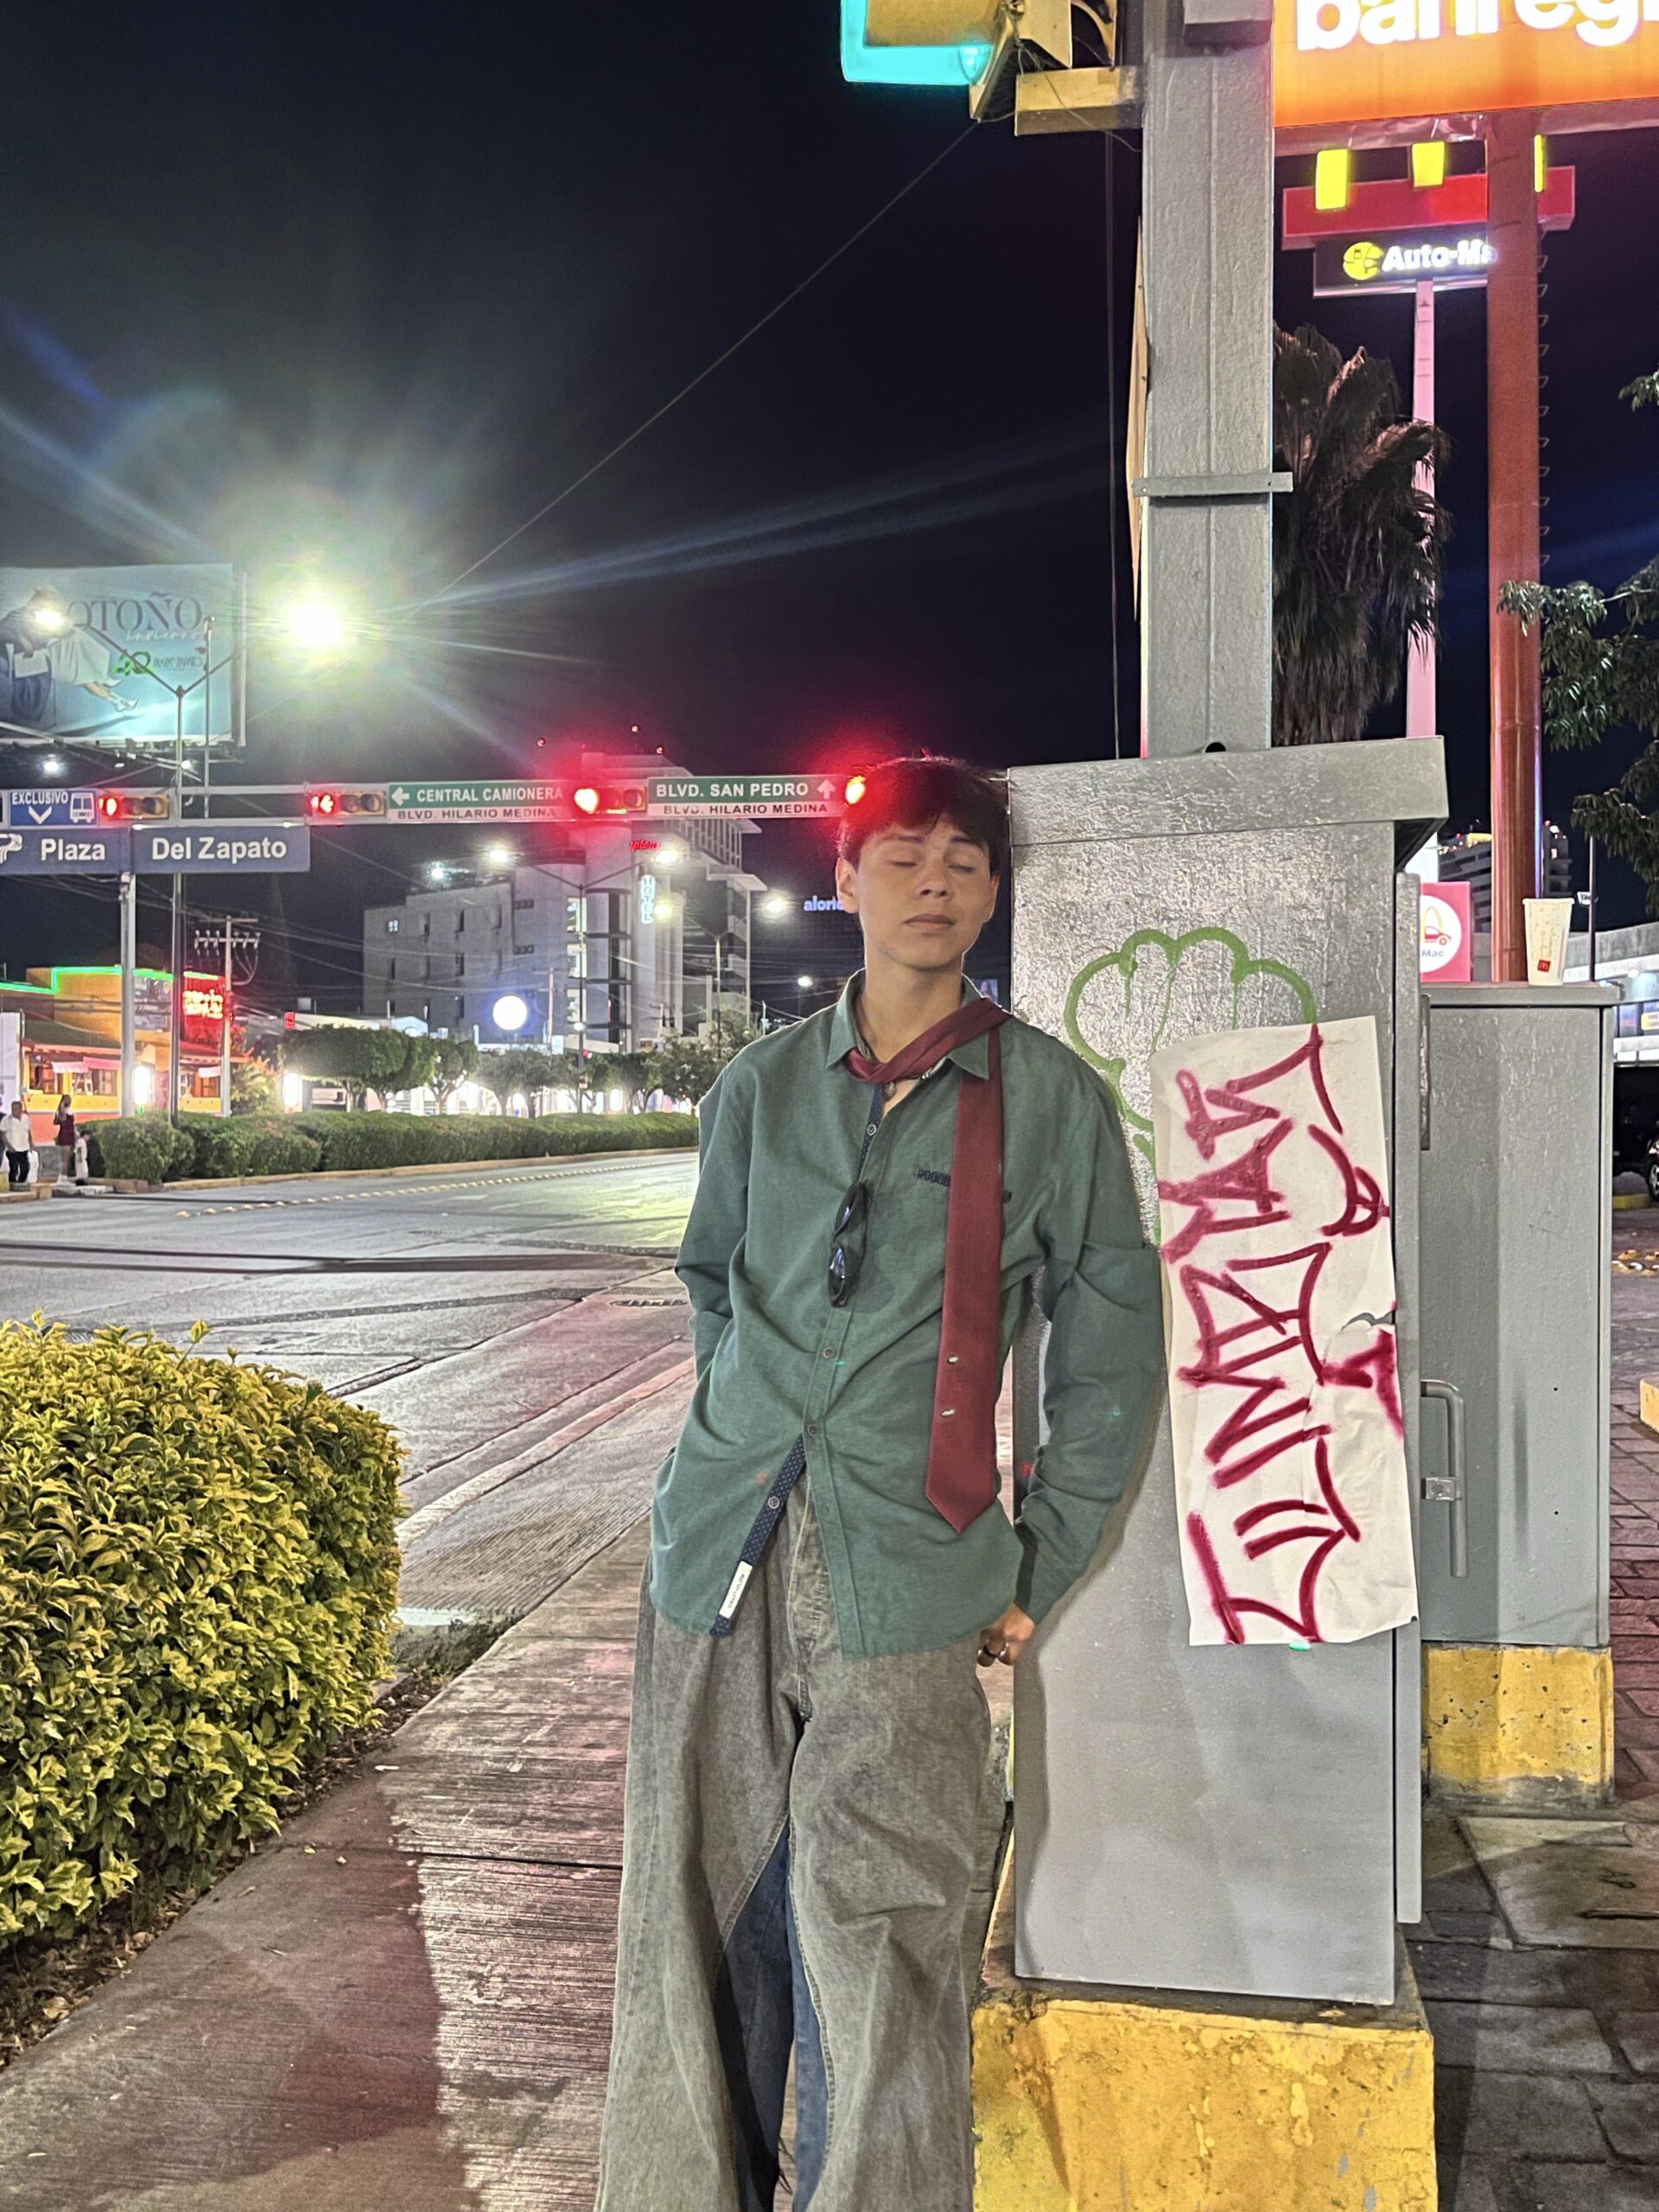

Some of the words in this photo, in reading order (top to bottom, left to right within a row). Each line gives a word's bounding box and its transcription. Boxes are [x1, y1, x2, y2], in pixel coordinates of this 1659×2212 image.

[416, 787, 479, 803] CENTRAL
[482, 786, 563, 802] CAMIONERA
[656, 784, 703, 798] BLVD.
[709, 783, 745, 798] SAN
[750, 782, 809, 797] PEDRO
[12, 791, 69, 805] EXCLUSIVO
[397, 810, 438, 820] BLVD.
[442, 809, 499, 819] HILARIO
[503, 807, 556, 818] MEDINA
[709, 804, 767, 814] HILARIO
[772, 804, 828, 813] MEDINA
[41, 838, 105, 861] Plaza
[152, 837, 192, 860] Del
[198, 836, 287, 864] Zapato
